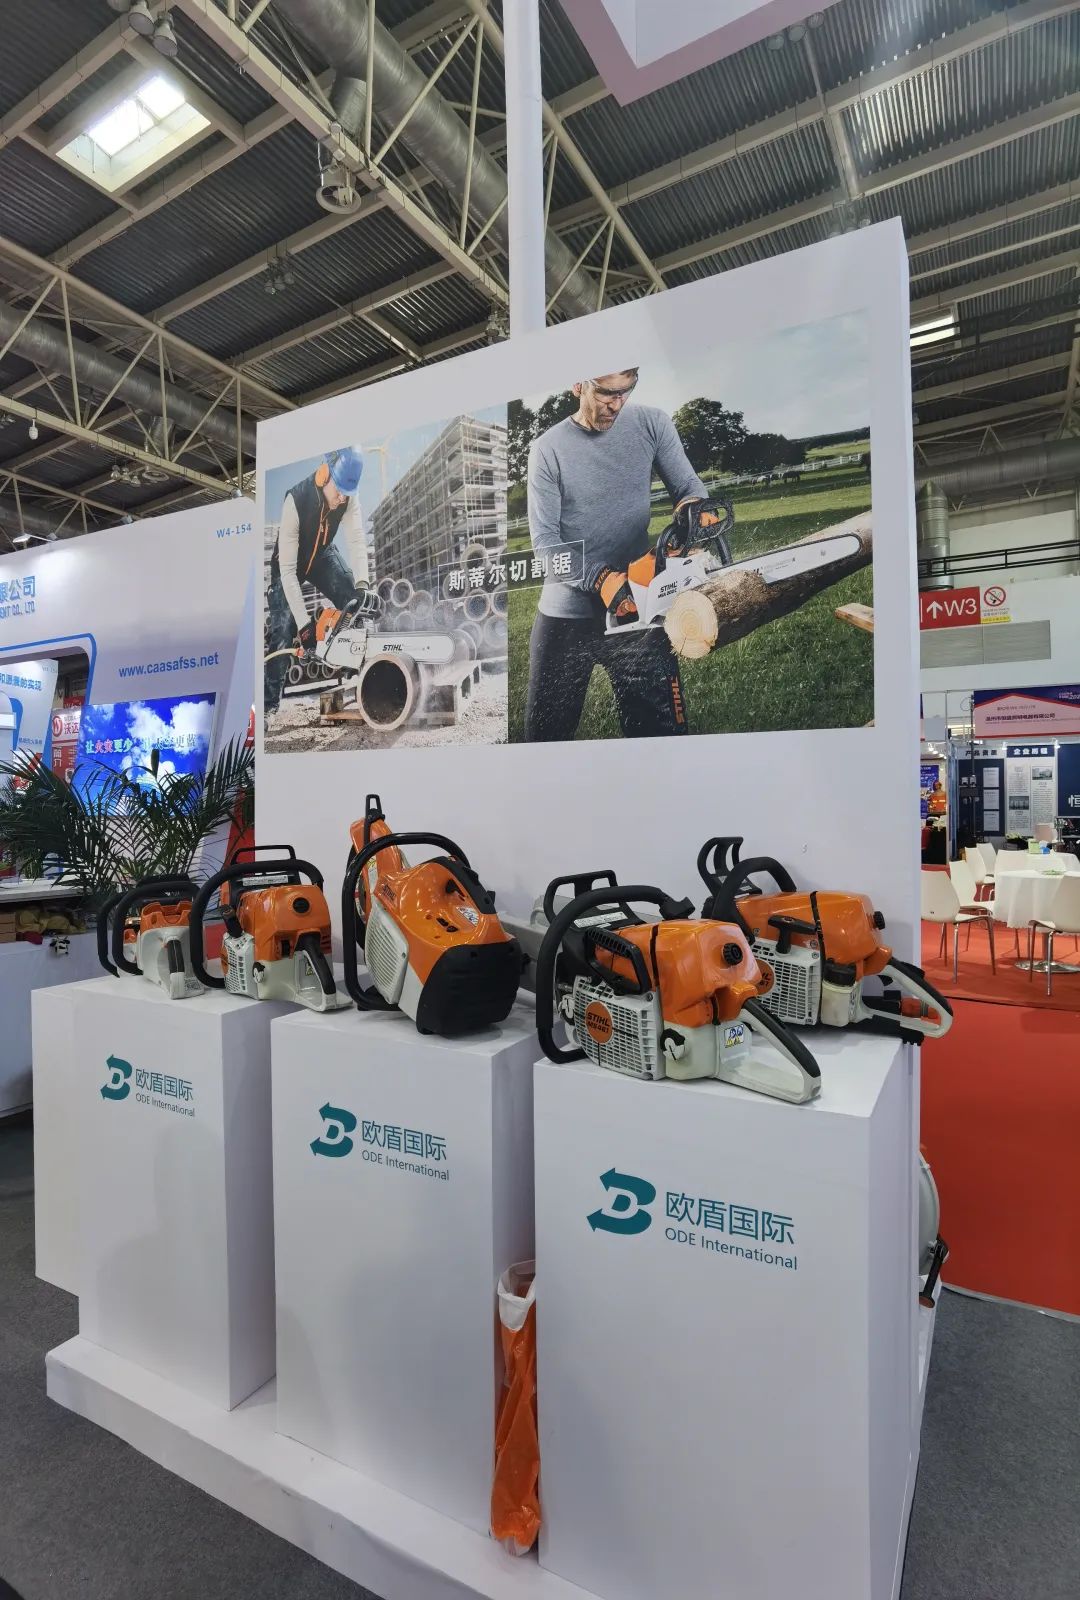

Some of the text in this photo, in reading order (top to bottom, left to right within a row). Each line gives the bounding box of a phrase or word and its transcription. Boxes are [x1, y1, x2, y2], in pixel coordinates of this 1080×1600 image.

[216, 523, 251, 538] W4-154
[449, 552, 572, 591] 斯蒂尔切割锯
[660, 581, 678, 593] STIHL
[944, 598, 977, 617] W3
[382, 644, 403, 652] STIHL
[118, 651, 219, 678] www.caasafss.net
[671, 676, 685, 725] STIHL
[587, 1011, 611, 1027] STIHL
[135, 1068, 194, 1102] 欧盾国际
[135, 1092, 196, 1117] ODE International
[361, 1120, 447, 1161] 欧盾国际
[361, 1149, 450, 1181] ODE International
[665, 1191, 795, 1245] 欧盾国际
[665, 1227, 798, 1270] ODE International
